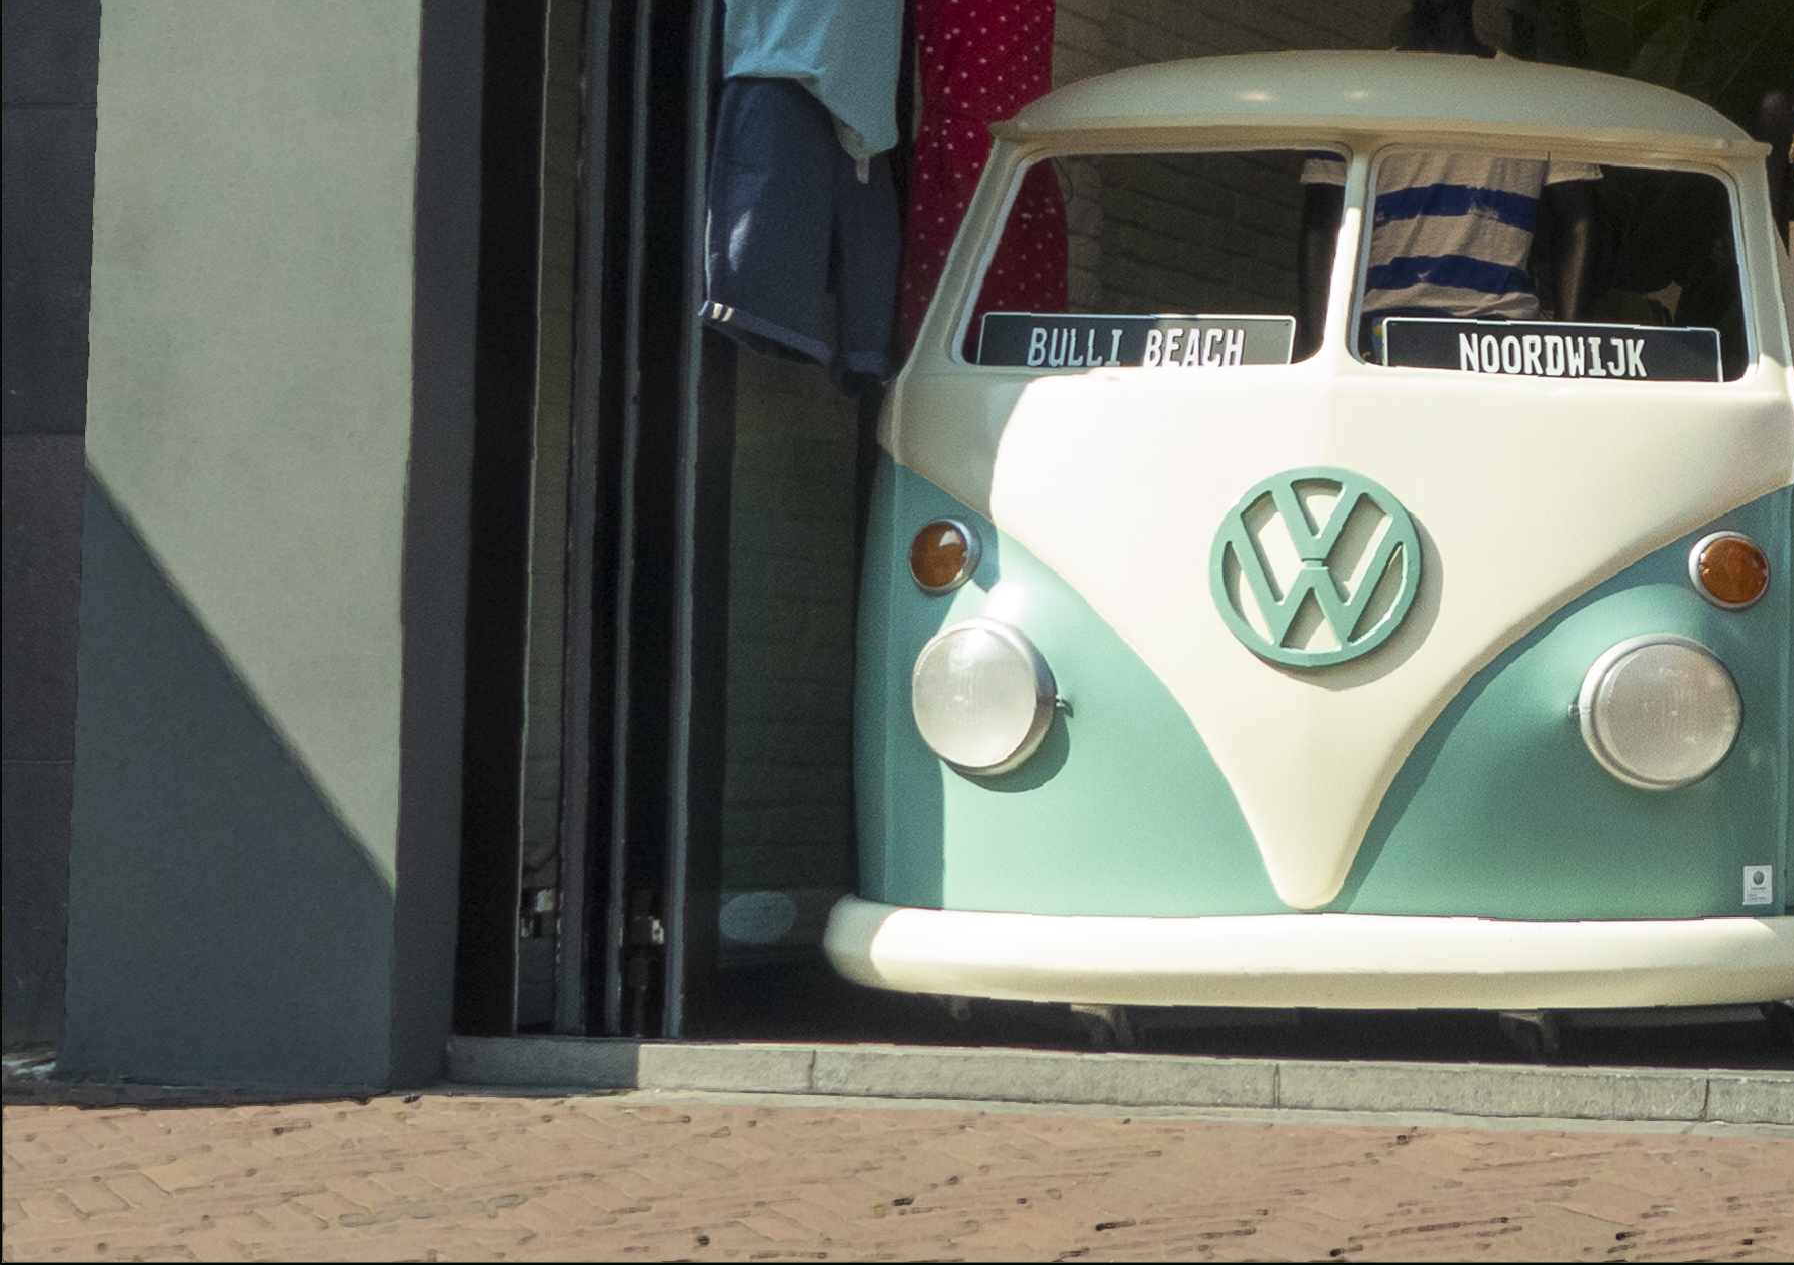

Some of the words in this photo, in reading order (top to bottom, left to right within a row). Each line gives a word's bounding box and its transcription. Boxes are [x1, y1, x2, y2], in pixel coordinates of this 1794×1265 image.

[1027, 326, 1123, 367] BULLI
[1142, 328, 1246, 367] BEACH
[1458, 332, 1647, 378] NOORDWIJK
